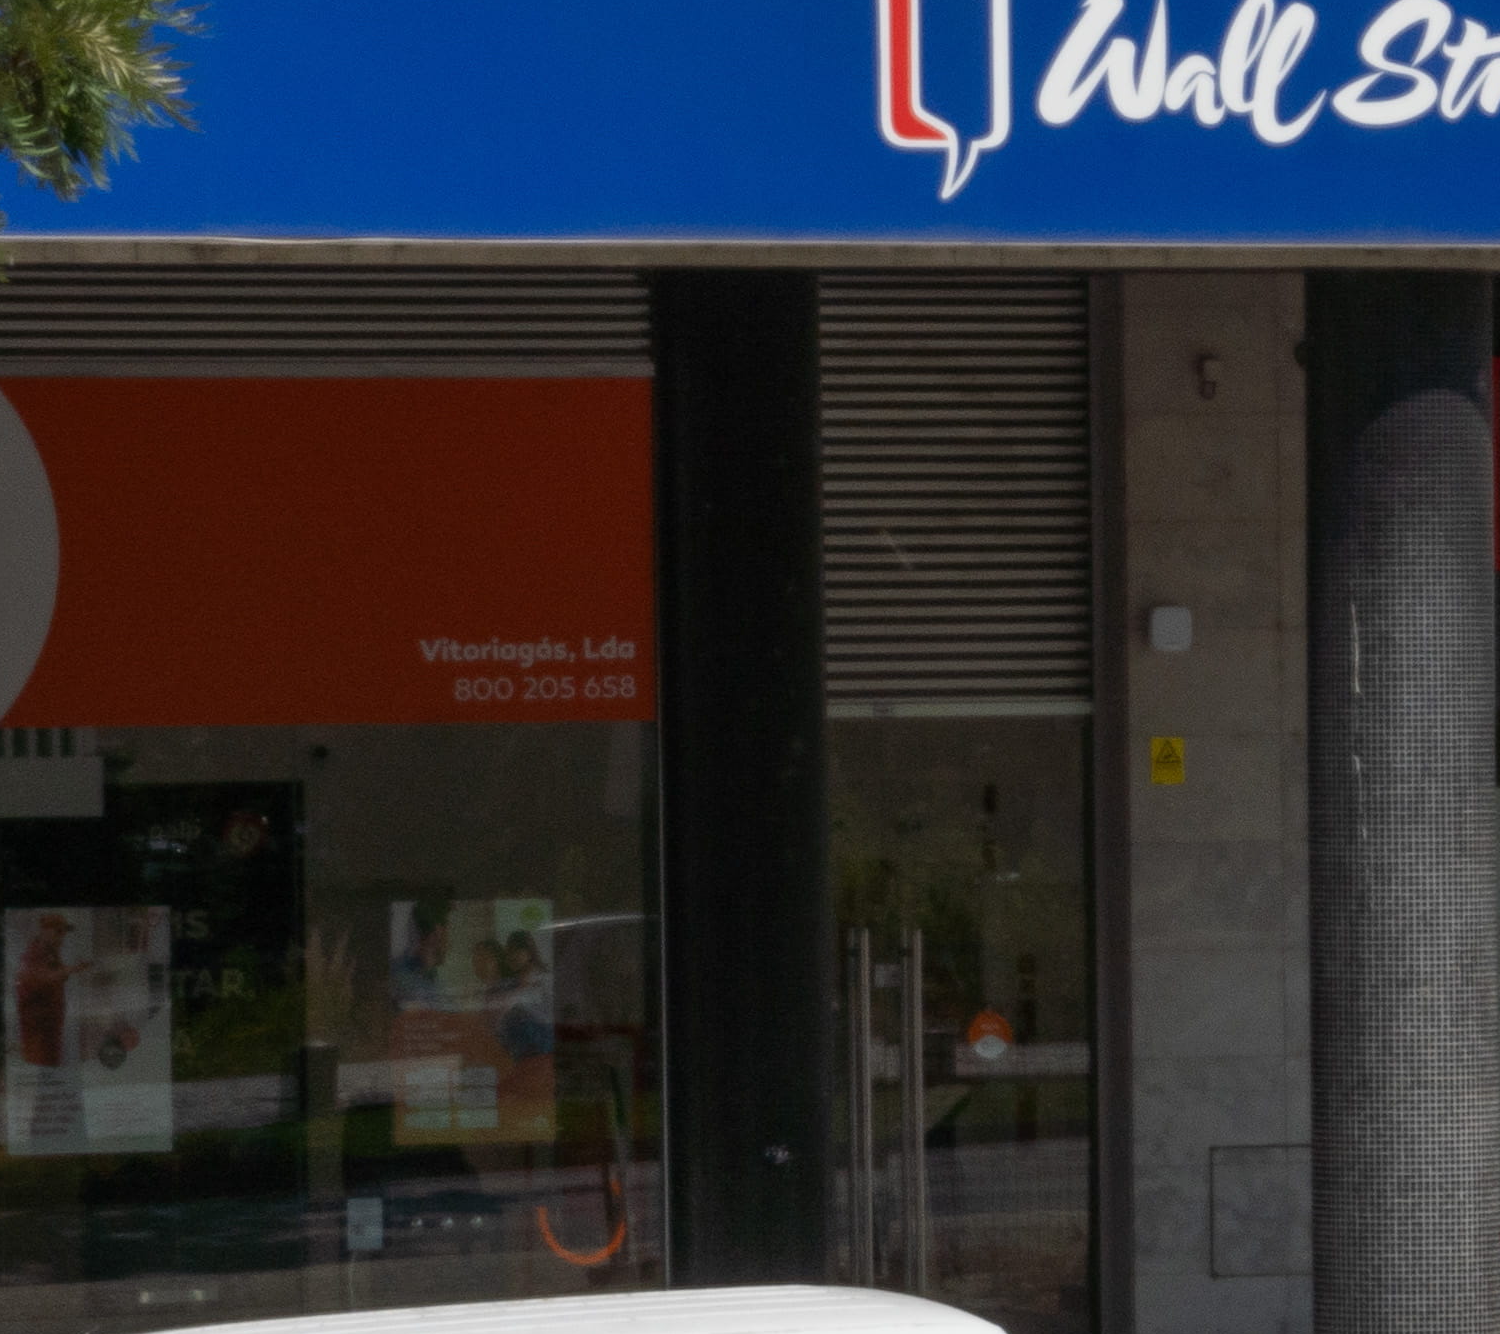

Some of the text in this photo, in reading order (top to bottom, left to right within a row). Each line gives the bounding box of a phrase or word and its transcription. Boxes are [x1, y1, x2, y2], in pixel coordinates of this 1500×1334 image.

[419, 635, 637, 669] Vitoriagás, Lda
[453, 674, 637, 702] 800 205 658
